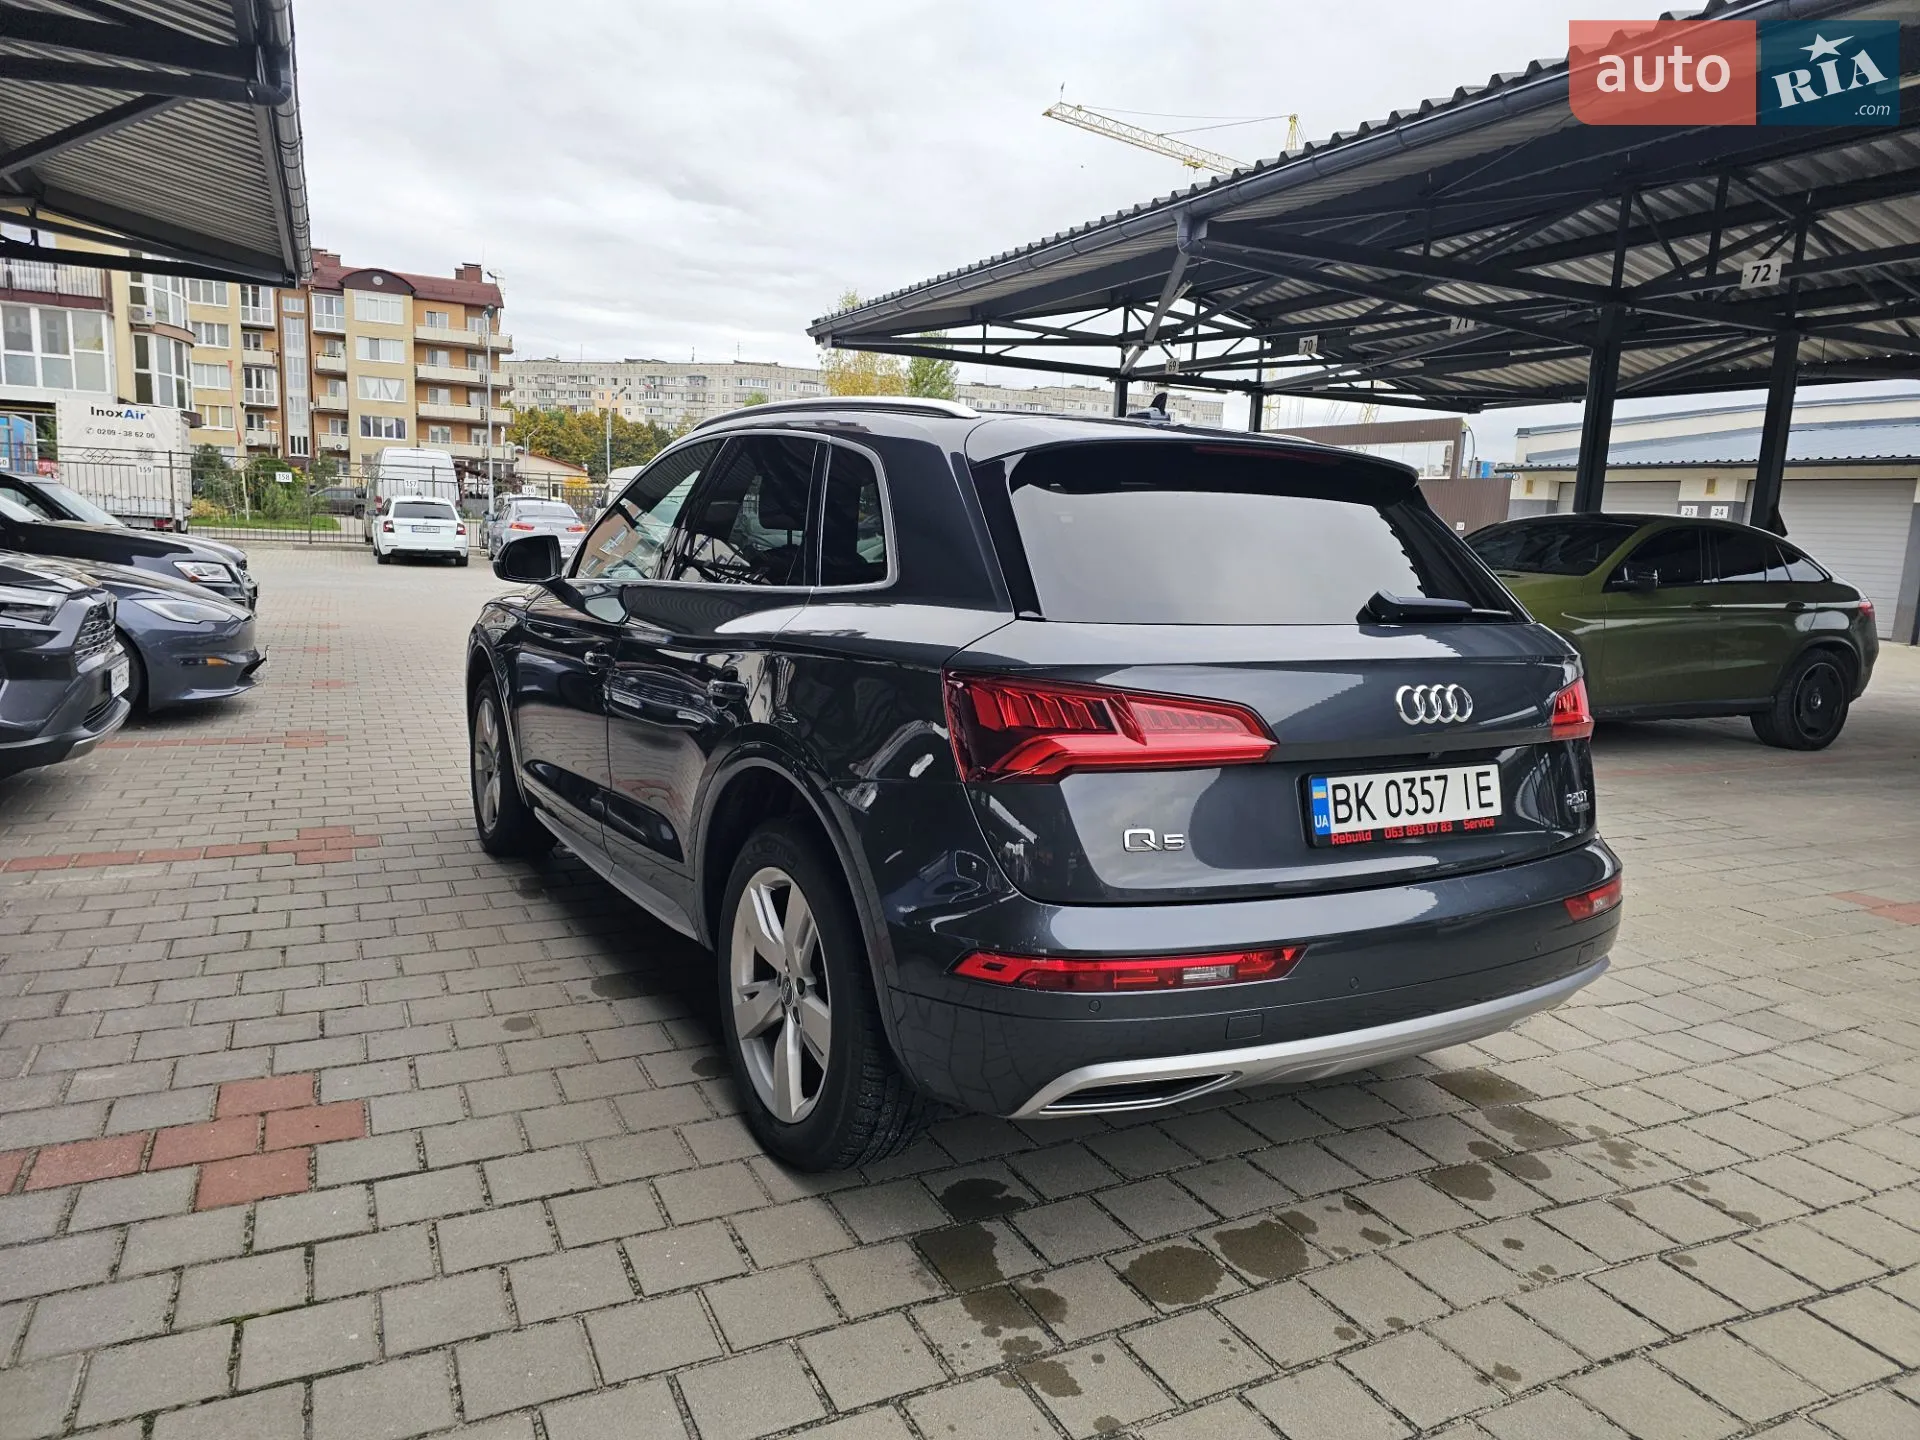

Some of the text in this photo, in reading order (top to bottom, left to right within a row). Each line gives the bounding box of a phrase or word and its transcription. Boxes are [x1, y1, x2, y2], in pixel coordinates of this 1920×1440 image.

[1751, 264, 1771, 284] 72
[1303, 339, 1313, 353] 70
[1168, 361, 1177, 372] 69
[90, 406, 146, 420] InoxAir
[1684, 507, 1694, 516] 23
[1714, 508, 1724, 517] 24
[1331, 771, 1494, 825] BK 0357 IE
[1314, 814, 1329, 828] UA
[1331, 817, 1495, 845] Rebuild 063 893 07 83 Service
[1123, 828, 1185, 852] Q5
